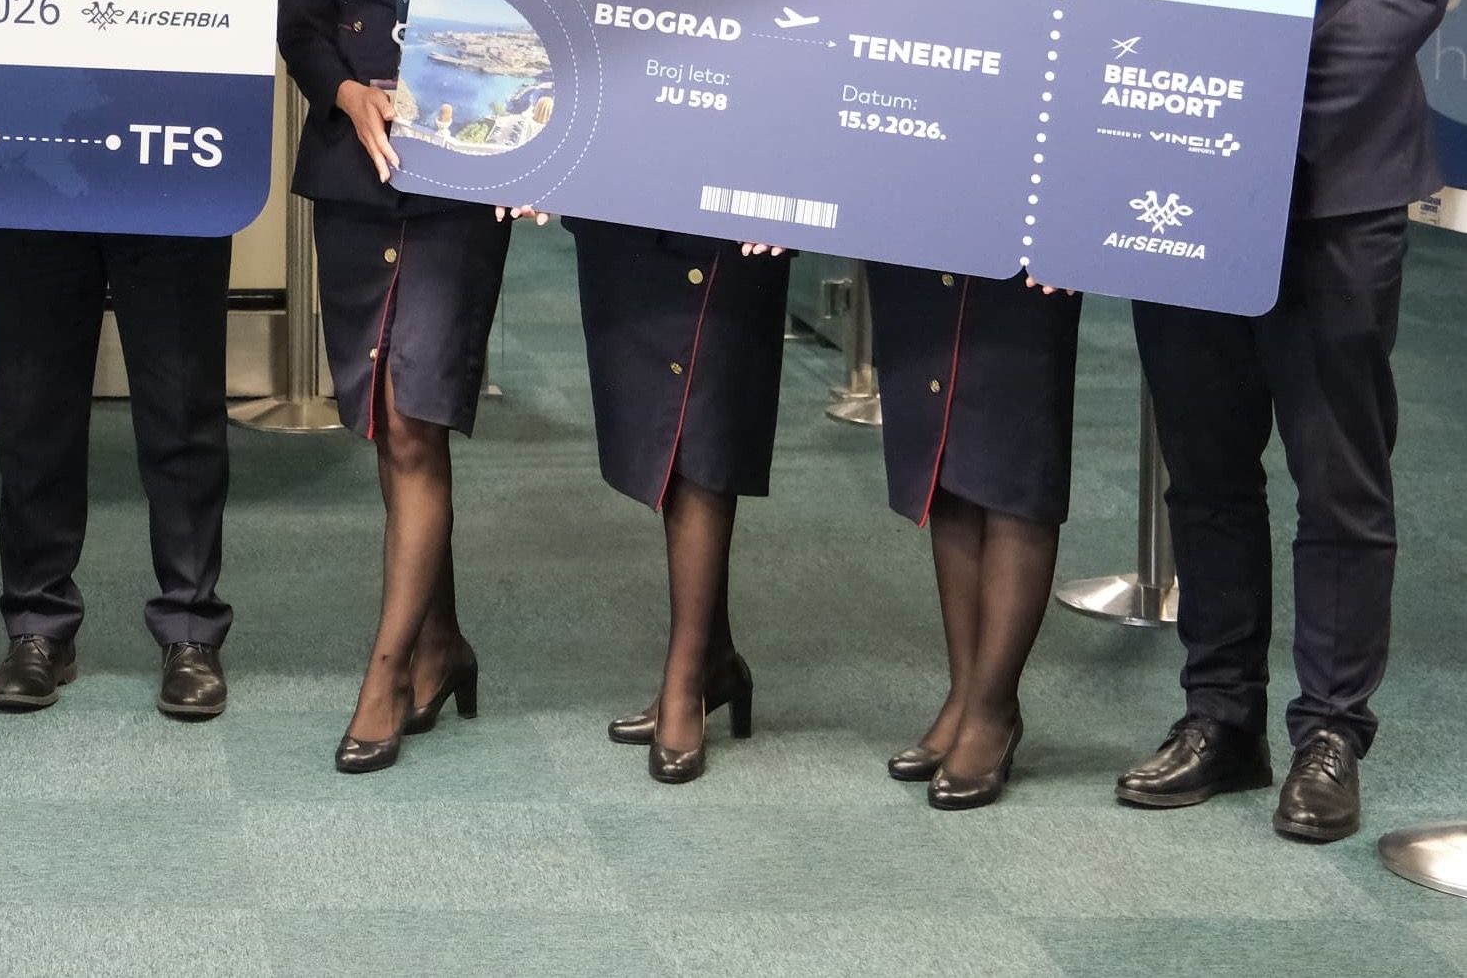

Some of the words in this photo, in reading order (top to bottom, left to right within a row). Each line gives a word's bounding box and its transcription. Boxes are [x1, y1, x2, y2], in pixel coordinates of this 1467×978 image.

[126, 9, 231, 29] AirSERBIA
[594, 3, 741, 42] BEOGRAD
[849, 34, 1001, 75] TENERIFE
[645, 59, 683, 84] Broj
[689, 64, 731, 86] leta:
[1104, 64, 1244, 100] BELGRADE
[655, 85, 684, 106] JU
[688, 89, 727, 111] 598
[842, 84, 917, 110] Datum:
[838, 109, 946, 141] 15.9.2026.
[130, 124, 223, 168] TFS
[1150, 131, 1210, 148] VINCI
[1102, 232, 1206, 260] AirSERBIA
